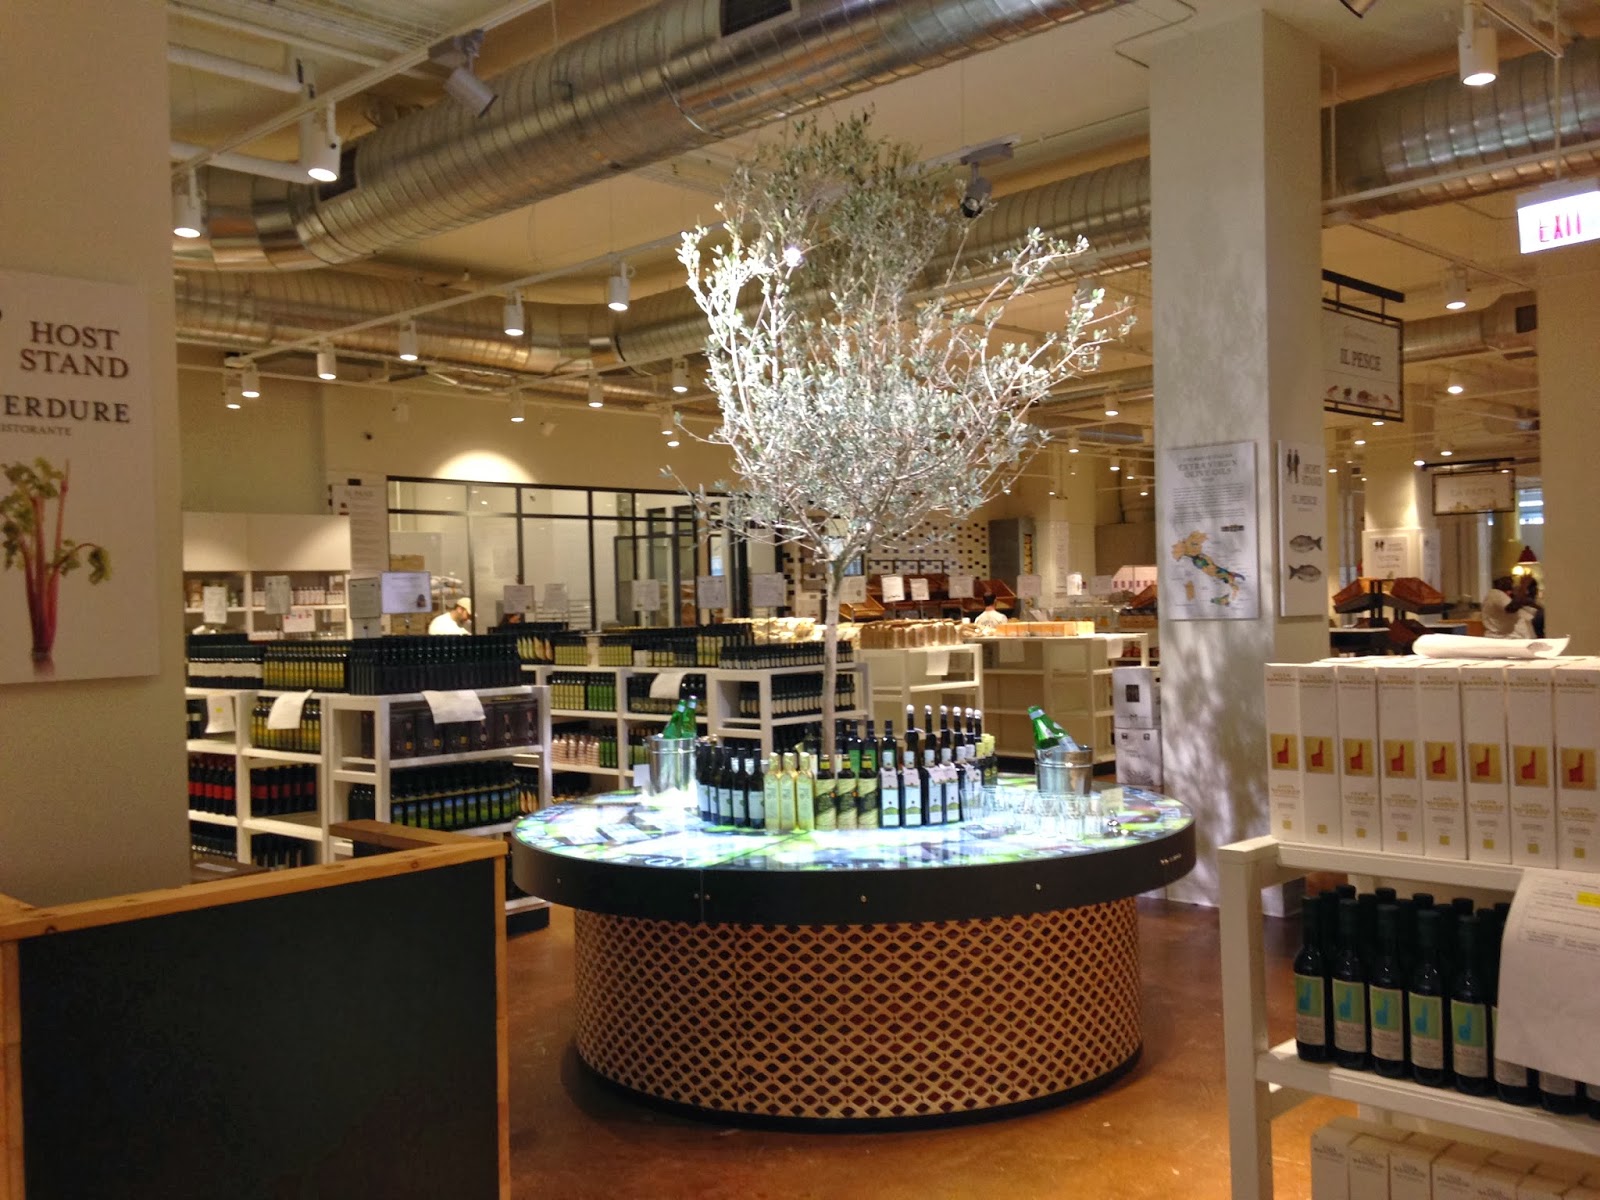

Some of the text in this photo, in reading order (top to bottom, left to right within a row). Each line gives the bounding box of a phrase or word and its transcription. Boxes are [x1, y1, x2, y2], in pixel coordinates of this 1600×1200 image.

[29, 320, 120, 351] HOST
[20, 348, 129, 379] STAND
[1351, 350, 1382, 372] PESCE
[0, 394, 130, 424] ERDURE
